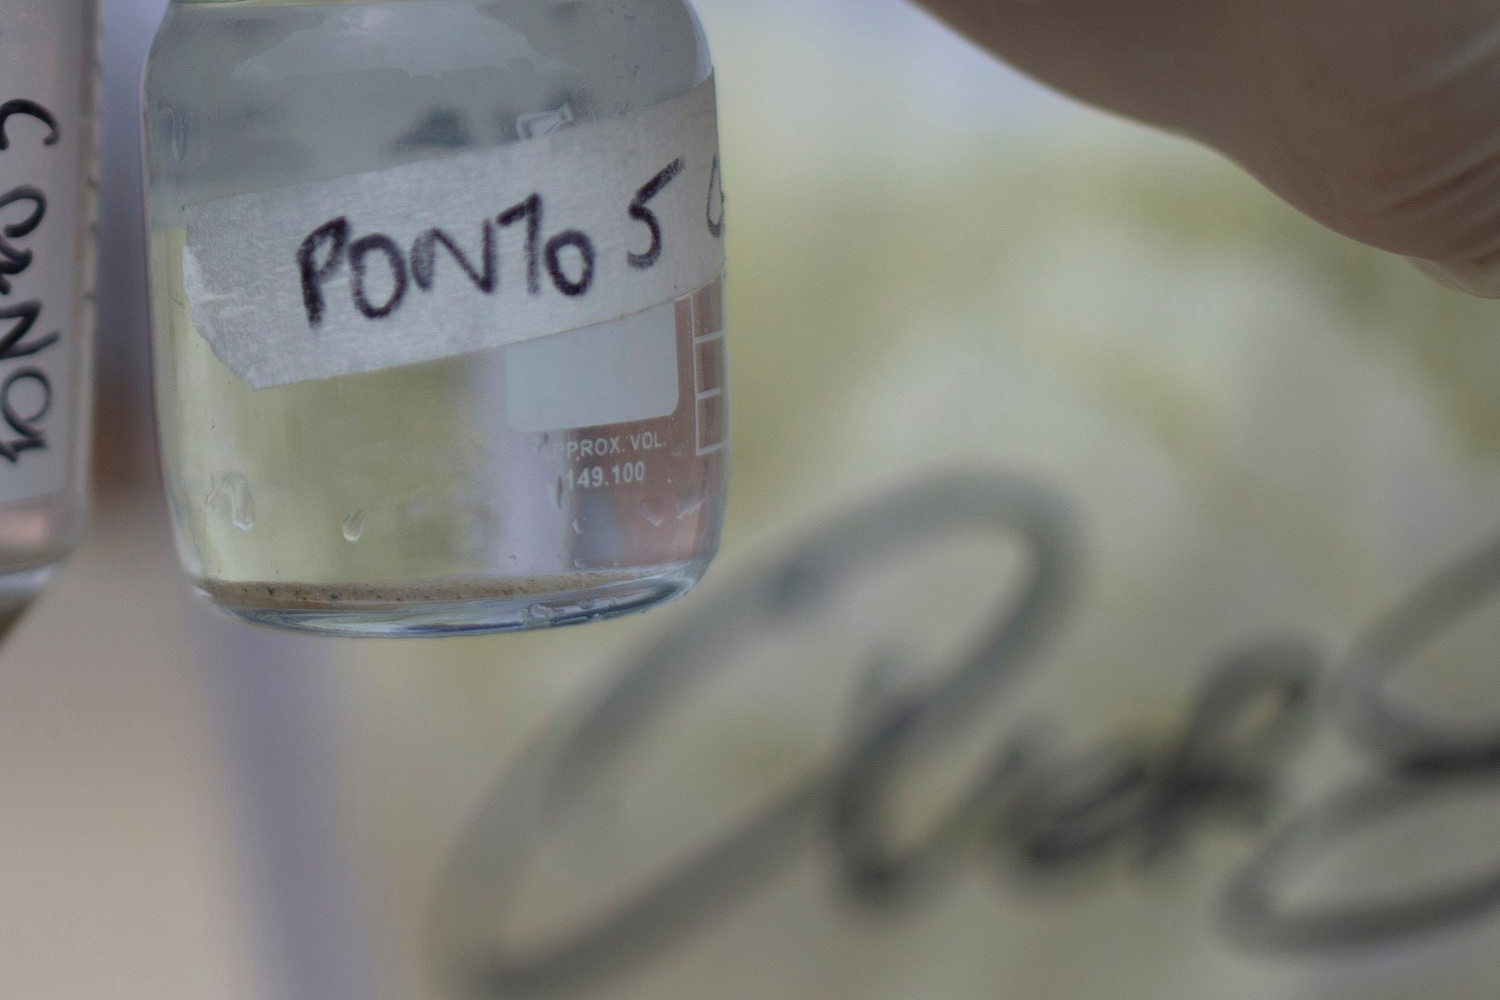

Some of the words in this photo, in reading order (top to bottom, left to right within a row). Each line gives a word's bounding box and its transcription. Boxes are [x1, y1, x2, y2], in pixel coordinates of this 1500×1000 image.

[297, 193, 597, 327] PONTO
[627, 156, 686, 271] 5
[538, 435, 625, 460] PPROX.
[629, 431, 667, 451] VOL.
[564, 460, 645, 490] 149.100
